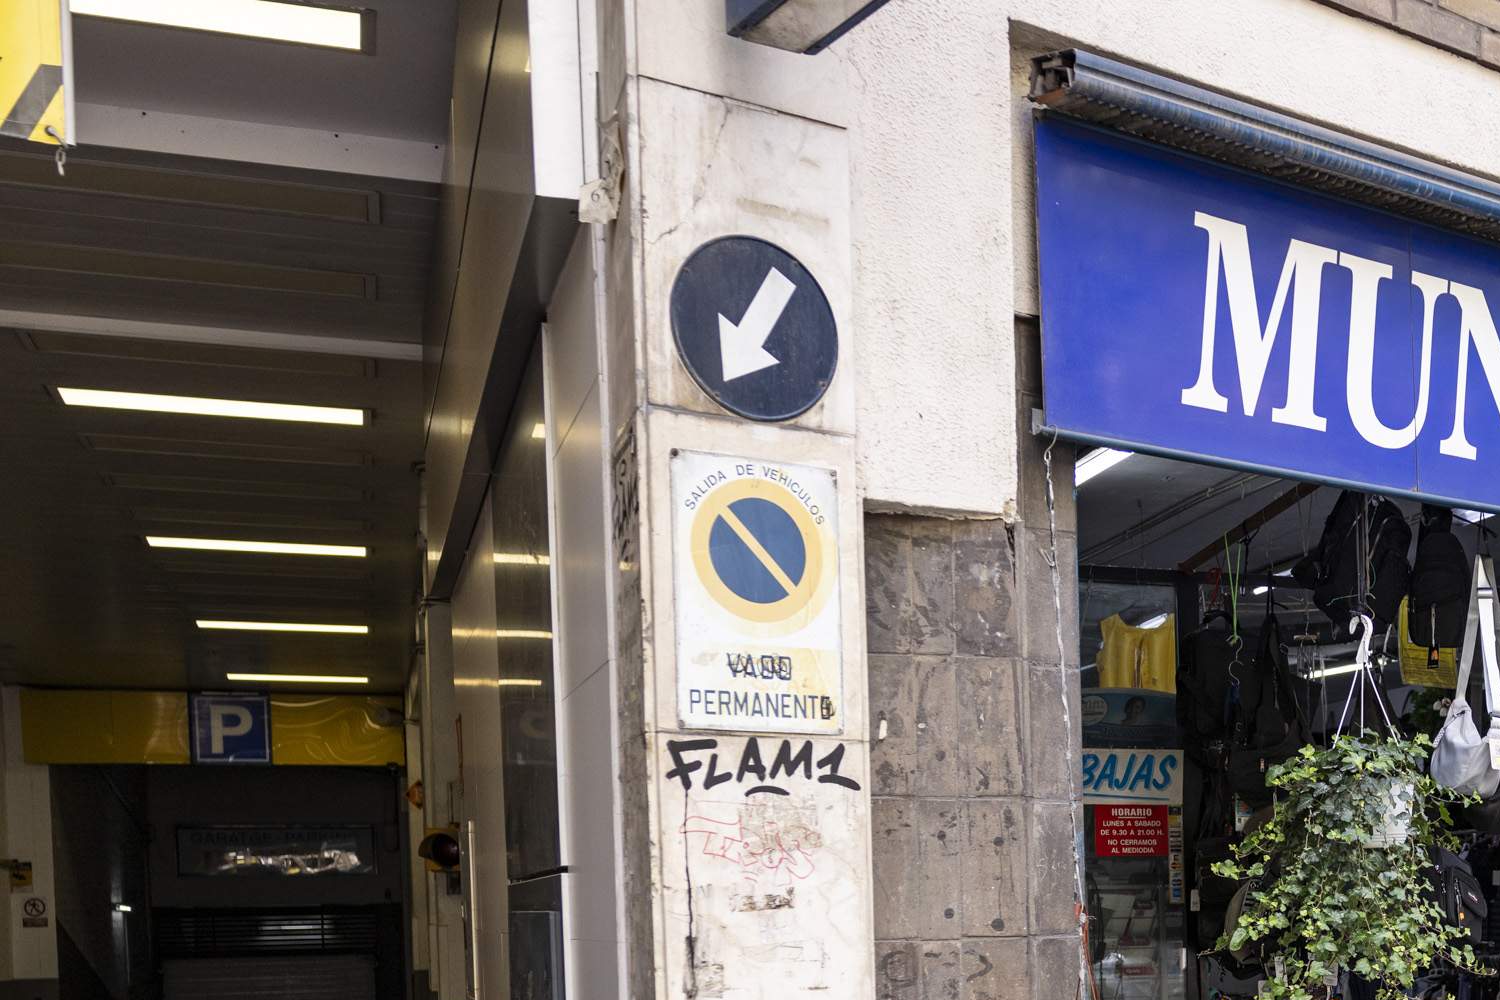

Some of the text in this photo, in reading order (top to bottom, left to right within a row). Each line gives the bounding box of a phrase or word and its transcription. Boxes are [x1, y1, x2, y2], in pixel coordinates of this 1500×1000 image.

[685, 464, 826, 525] SALIDA DE VEHICULOS
[210, 704, 253, 754] P
[1112, 808, 1152, 817] HORARIO
